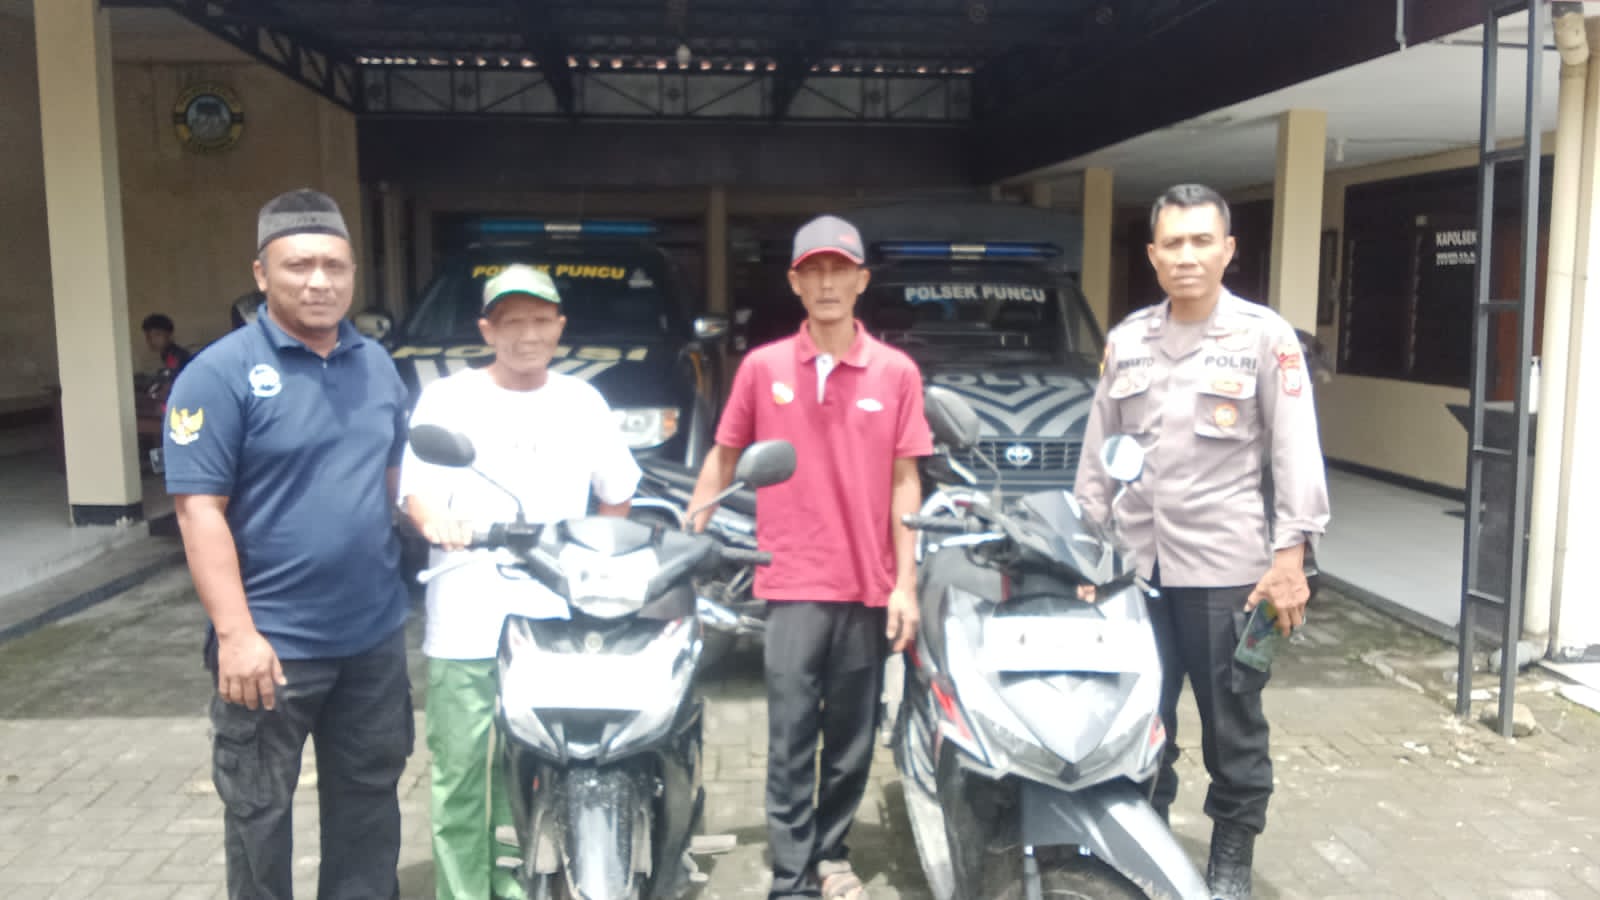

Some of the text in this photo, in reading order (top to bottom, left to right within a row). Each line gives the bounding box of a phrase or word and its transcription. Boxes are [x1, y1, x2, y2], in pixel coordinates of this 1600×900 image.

[555, 264, 625, 280] PUNCU
[905, 286, 1046, 304] POLSEK PUNCU
[392, 345, 648, 361] POISI
[1204, 355, 1257, 370] POLRI
